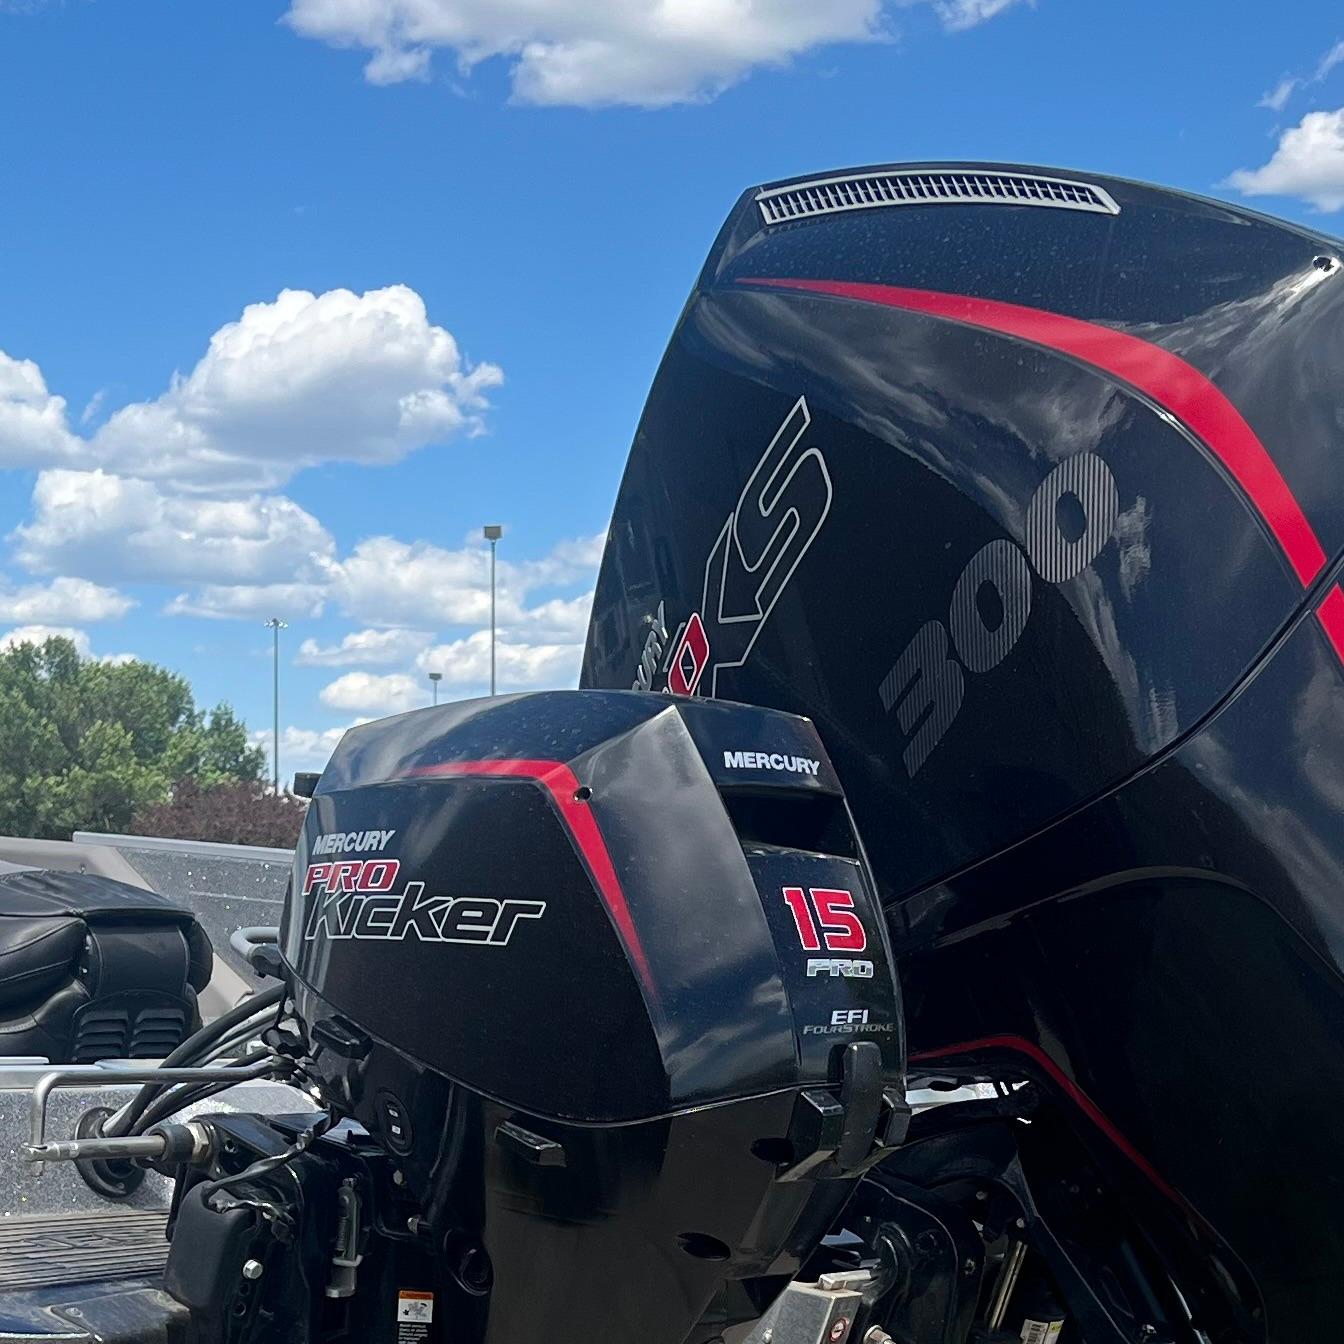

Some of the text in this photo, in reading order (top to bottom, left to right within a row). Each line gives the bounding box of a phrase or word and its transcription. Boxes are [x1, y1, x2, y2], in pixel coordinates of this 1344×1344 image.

[878, 451, 1119, 778] 300
[723, 751, 820, 775] MERCURY
[312, 829, 396, 855] MERCURY
[302, 859, 400, 895] PRO
[782, 887, 867, 952] 15
[807, 959, 874, 979] PRO
[830, 1009, 869, 1025] EFI
